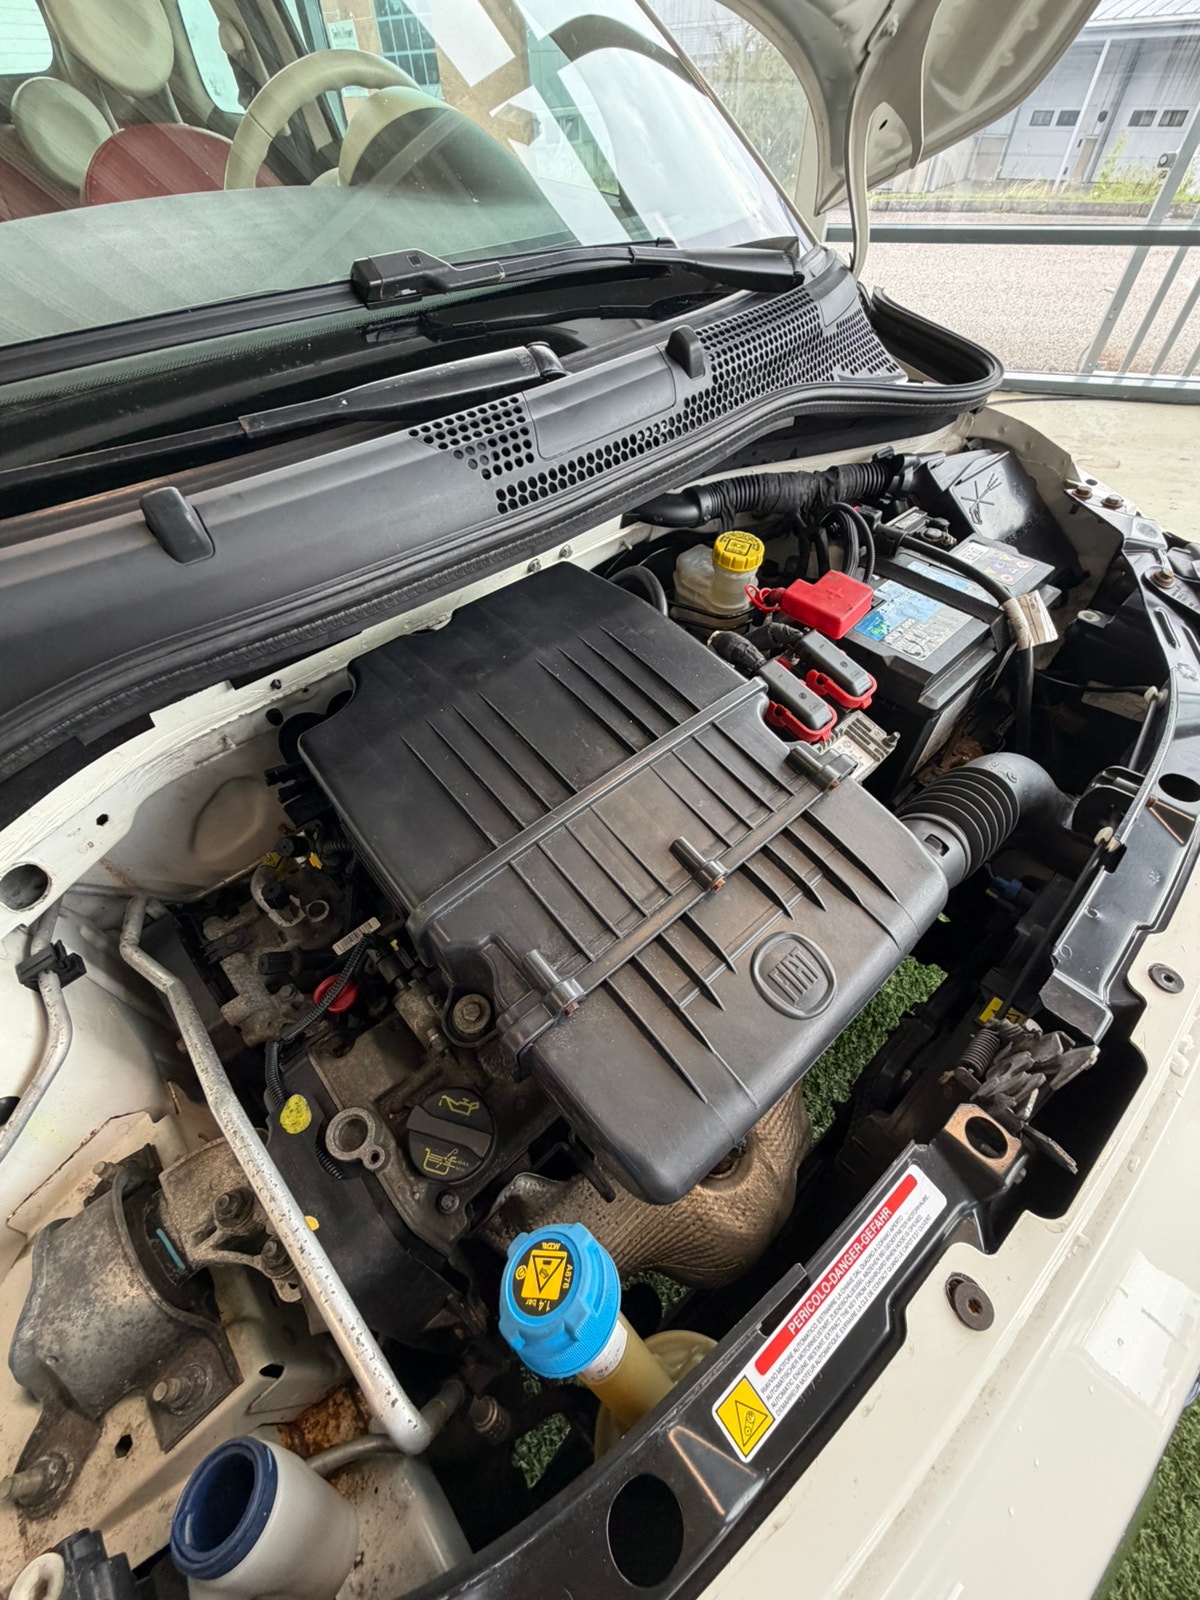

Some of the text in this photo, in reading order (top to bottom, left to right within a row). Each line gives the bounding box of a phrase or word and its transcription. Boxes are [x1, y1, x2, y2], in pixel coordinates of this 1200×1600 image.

[767, 945, 821, 1004] FIAT
[770, 1377, 794, 1409] AUTOMATIC
[792, 1360, 808, 1381] ENGINE
[823, 1316, 842, 1340] EXTRACT
[840, 1307, 849, 1319] THE
[847, 1297, 857, 1310] KEY
[854, 1284, 867, 1300] FROM
[864, 1259, 887, 1287] DASHBOARD
[884, 1246, 896, 1262] WHEN
[894, 1234, 906, 1249] HOOD
[775, 1351, 794, 1375] MOTORE
[835, 1292, 842, 1300] LA
[852, 1267, 861, 1279] DAL
[775, 1383, 801, 1416] DEMARREUR
[798, 1362, 816, 1386] MOTEUR
[855, 1303, 862, 1312] LA
[866, 1288, 873, 1297] DE
[871, 1269, 888, 1291] CONTACT
[885, 1255, 899, 1272] QUAND
[896, 1250, 903, 1258] LE
[900, 1236, 913, 1252] CAPOT
[911, 1229, 919, 1239] EST
[786, 1206, 892, 1335] PERICOLO-DANGER-GEFAHR
[765, 1358, 799, 1402] AUTOMATISCHER
